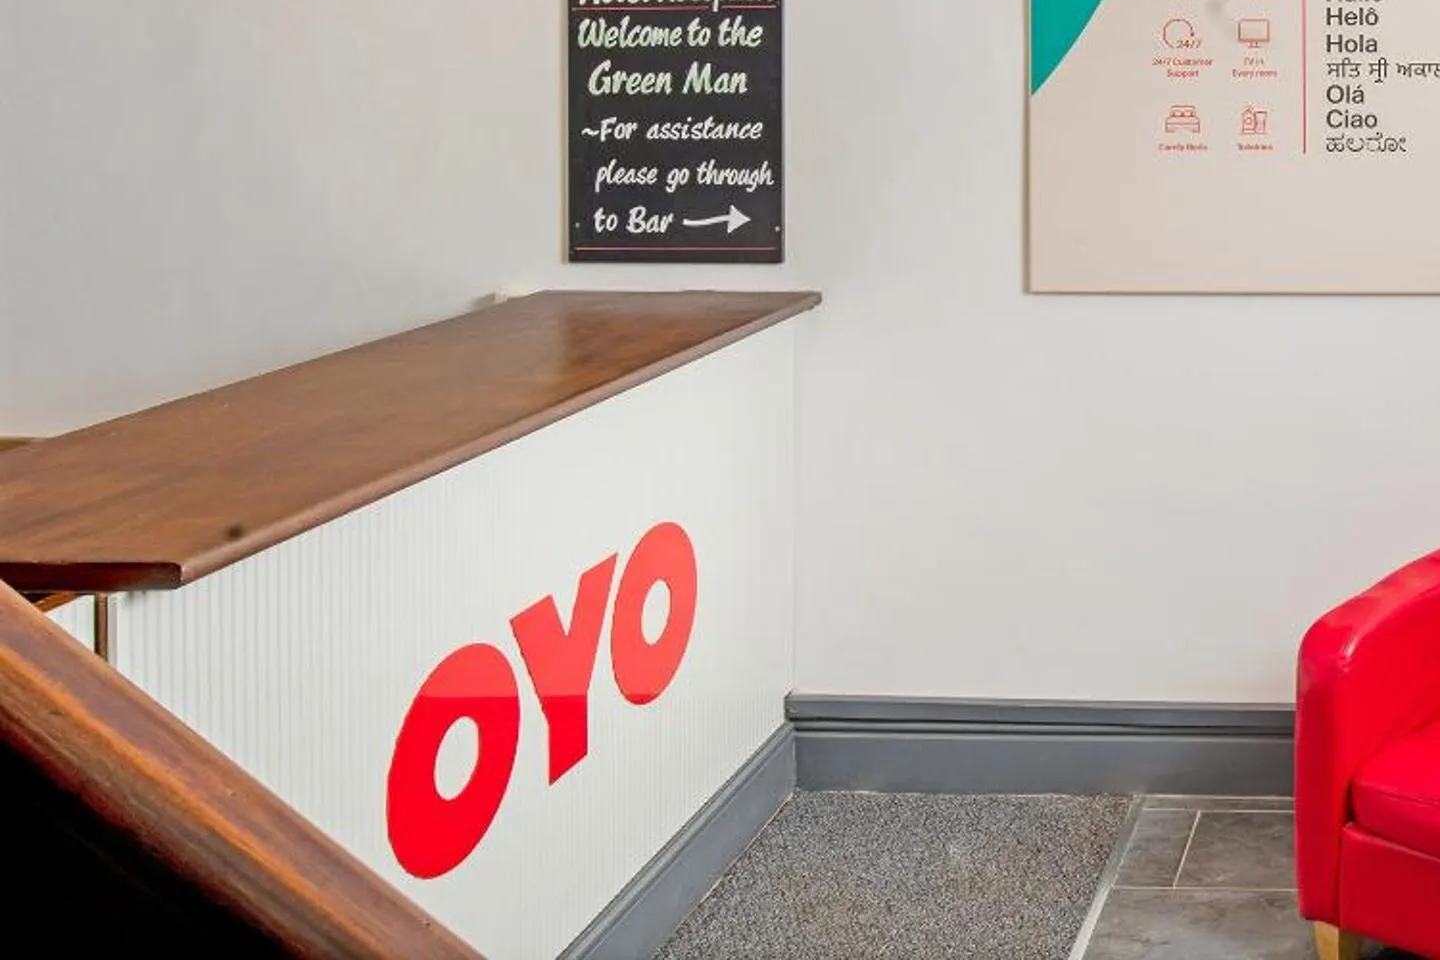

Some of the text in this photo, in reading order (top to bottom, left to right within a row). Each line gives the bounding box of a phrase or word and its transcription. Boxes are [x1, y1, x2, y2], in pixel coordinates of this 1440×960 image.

[1325, 6, 1380, 26] Helô
[578, 15, 764, 49] Welcome to the
[1325, 33, 1378, 53] Hola
[587, 59, 748, 96] Green Man
[1325, 83, 1366, 105] Olá
[646, 116, 764, 141] assistance
[1325, 108, 1379, 129] Ciao
[595, 159, 775, 192] please go through
[593, 205, 675, 234] to Bar
[386, 521, 699, 880] OYO
